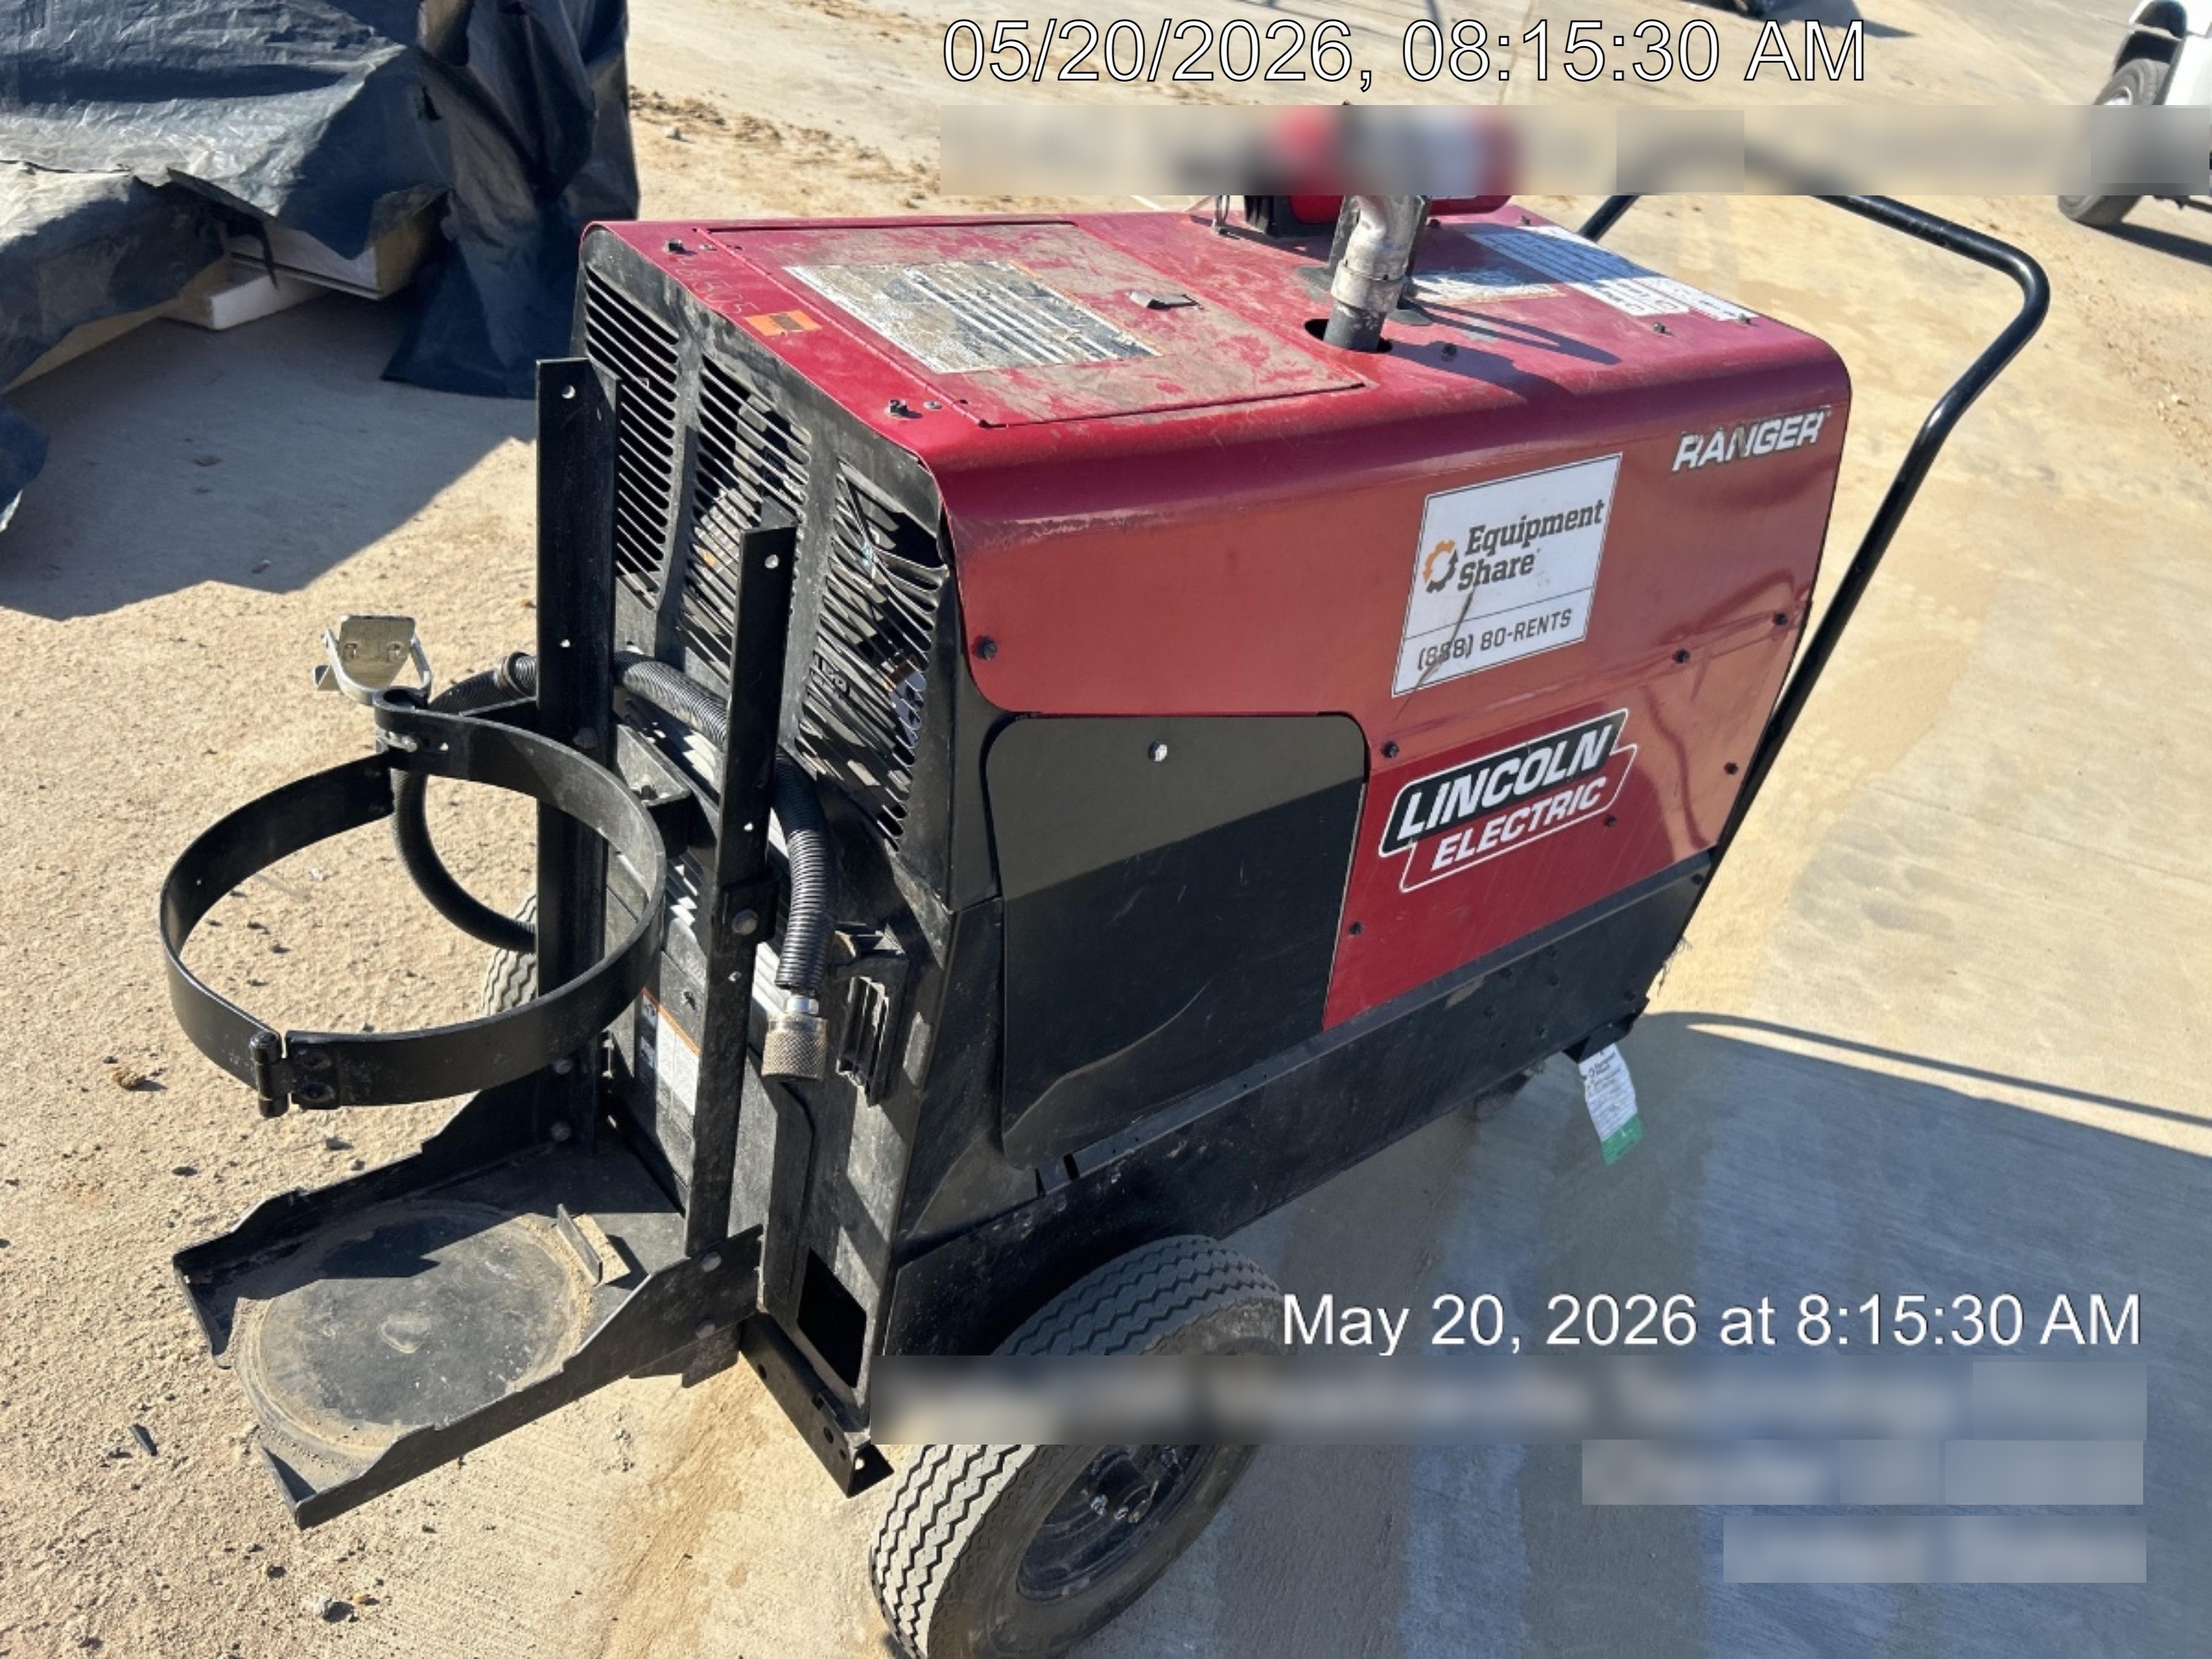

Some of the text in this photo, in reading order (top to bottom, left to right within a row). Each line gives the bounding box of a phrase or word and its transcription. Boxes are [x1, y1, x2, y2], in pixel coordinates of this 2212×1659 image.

[1671, 410, 1825, 472] RANGER
[1465, 499, 1605, 557] Equipment
[1457, 553, 1535, 591] Share
[1417, 609, 1573, 671] (888) 80-RENTS
[1397, 724, 1613, 841] LINCOLN
[1430, 776, 1607, 871] ELECTRIC
